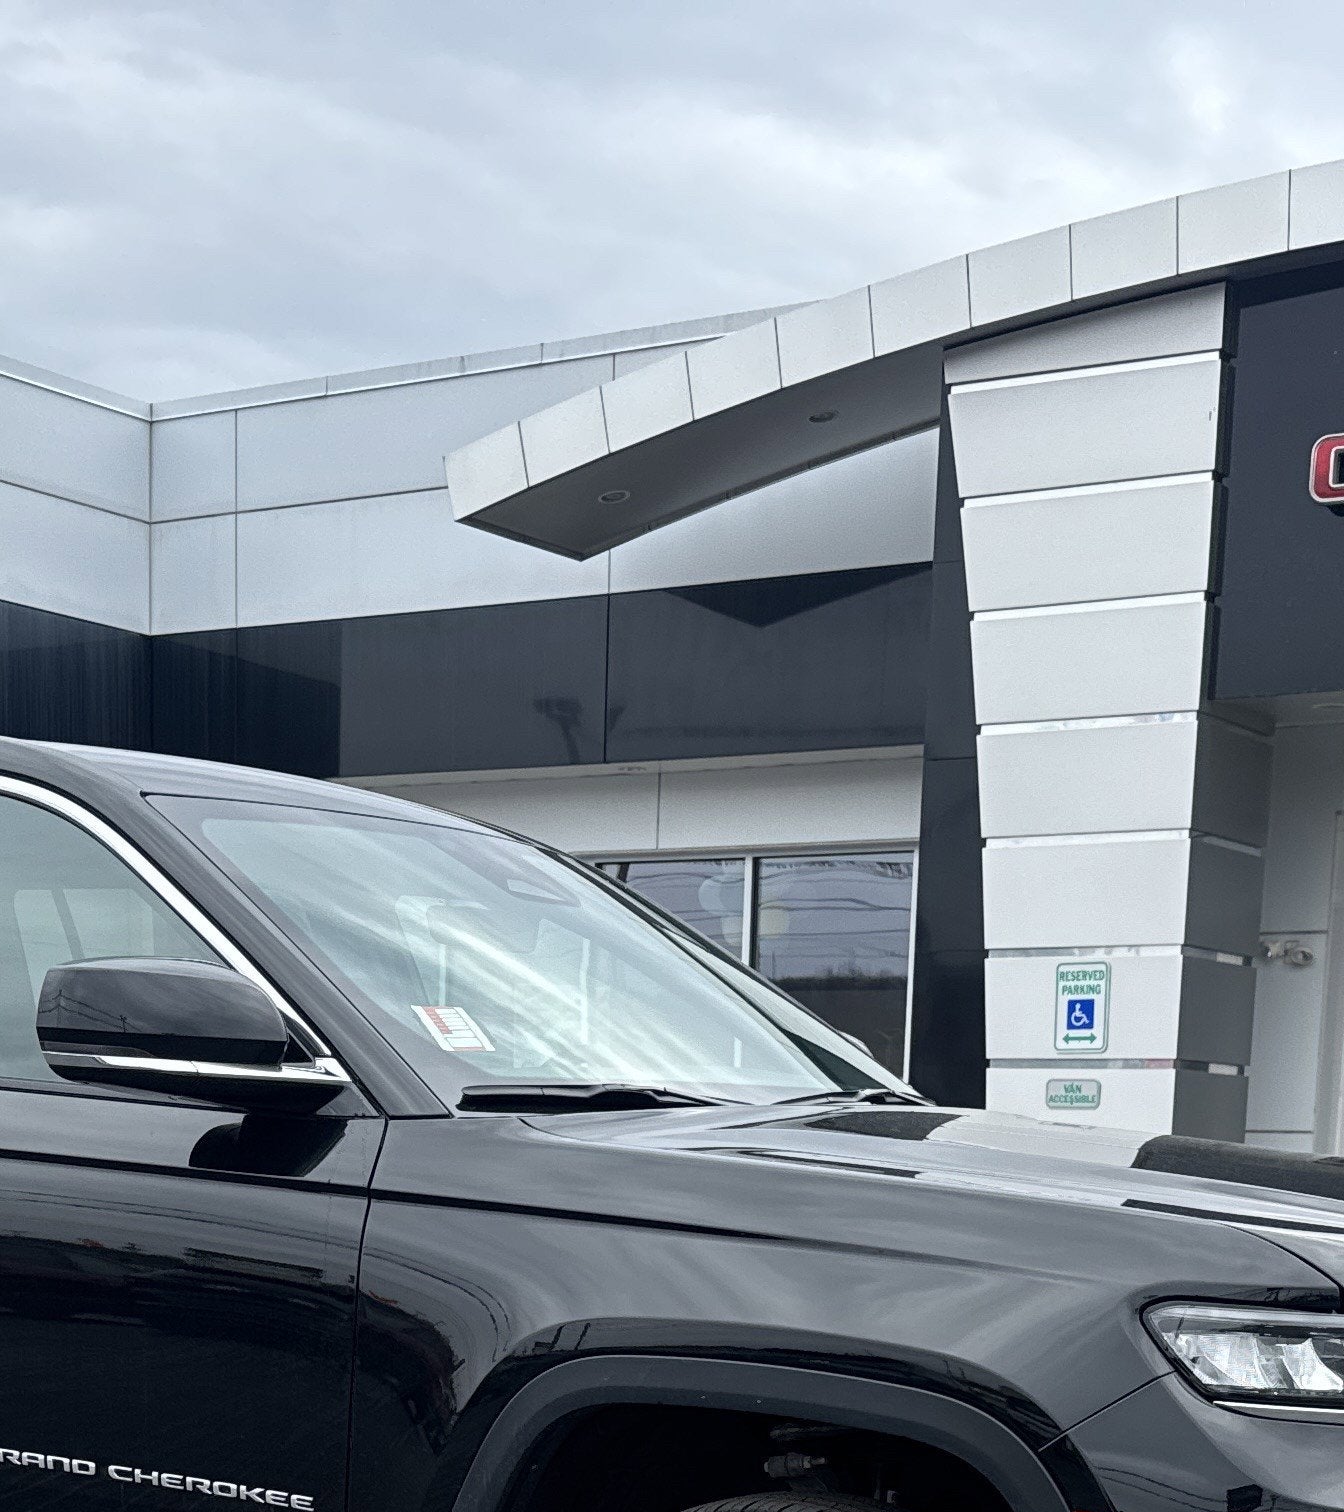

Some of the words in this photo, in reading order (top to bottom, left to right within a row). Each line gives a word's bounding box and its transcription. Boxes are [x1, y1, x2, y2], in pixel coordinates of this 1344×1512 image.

[1059, 969, 1106, 981] RESERVED
[1061, 984, 1102, 996] PARKING
[1063, 1083, 1083, 1094] VAN
[1048, 1094, 1097, 1104] ACCESSIBLE
[107, 1464, 315, 1512] CHEROKEE
